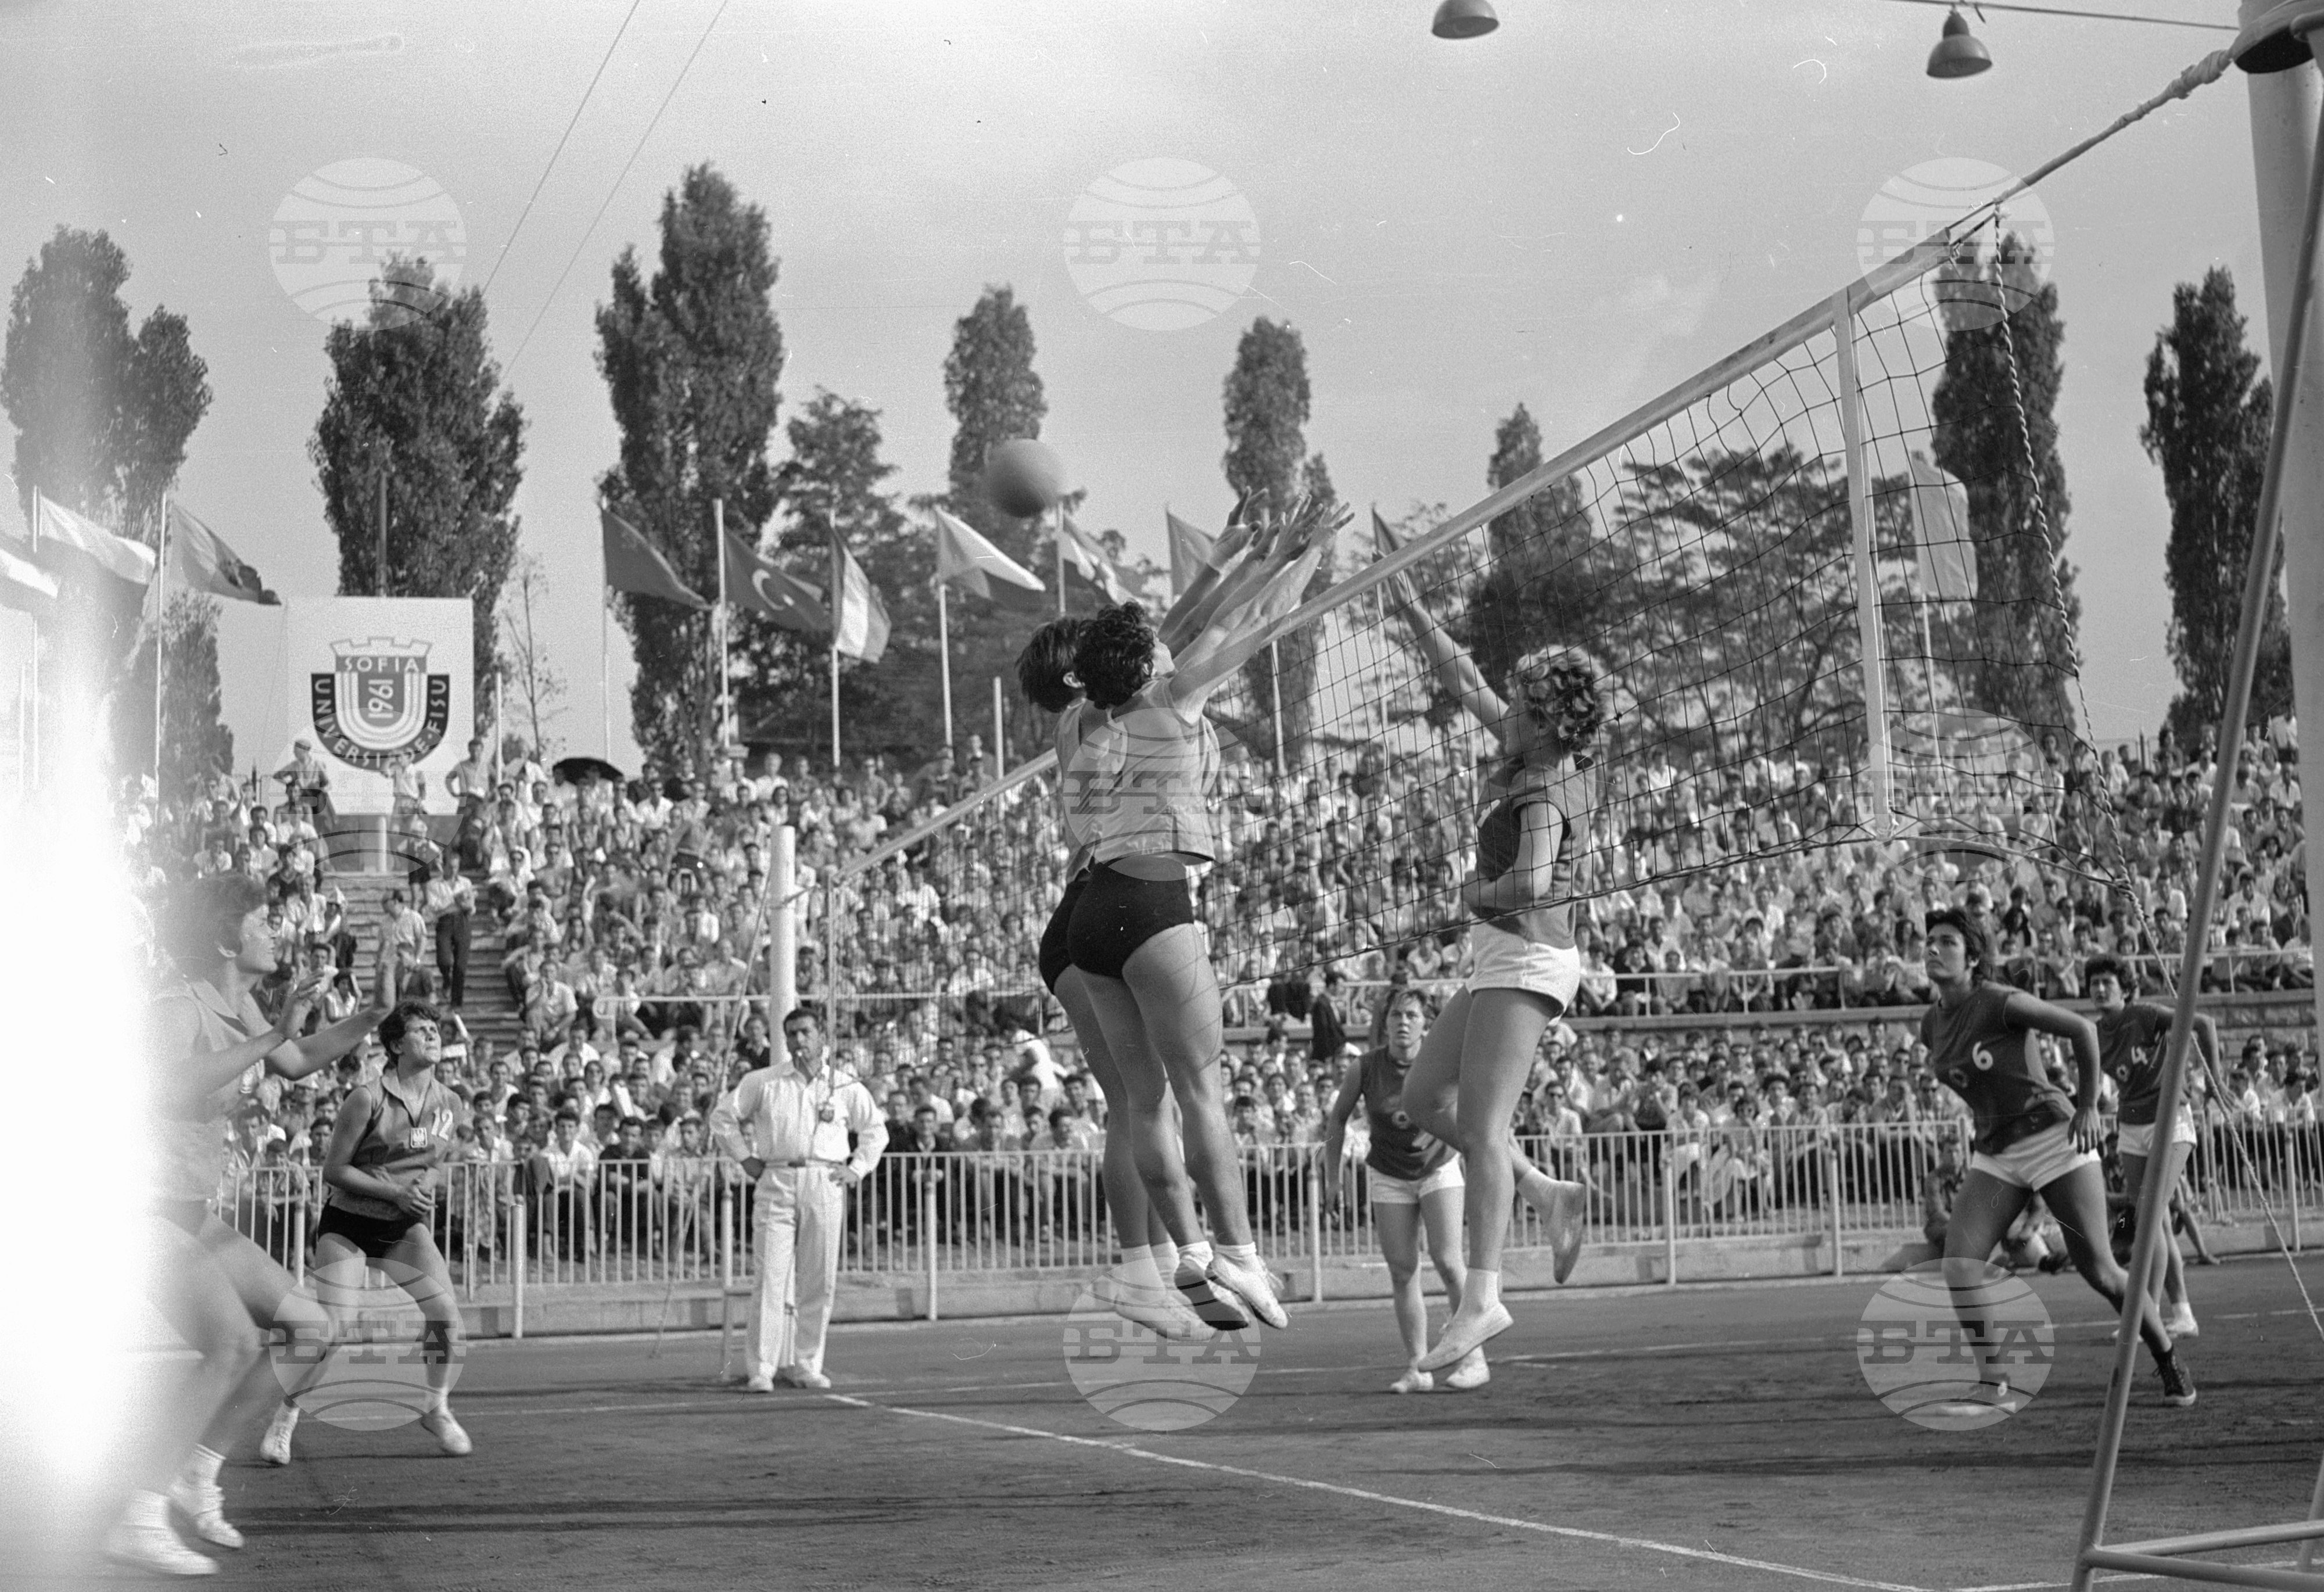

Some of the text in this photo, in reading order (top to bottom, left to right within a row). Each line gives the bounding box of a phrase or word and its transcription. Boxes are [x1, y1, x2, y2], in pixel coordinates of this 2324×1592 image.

[345, 656, 419, 673] SOFIA
[368, 679, 394, 719] 1961
[314, 679, 429, 769] UNIVERSIDE
[1972, 1041, 1993, 1071] 6
[2131, 1045, 2148, 1065] 4
[431, 1106, 453, 1141] 12
